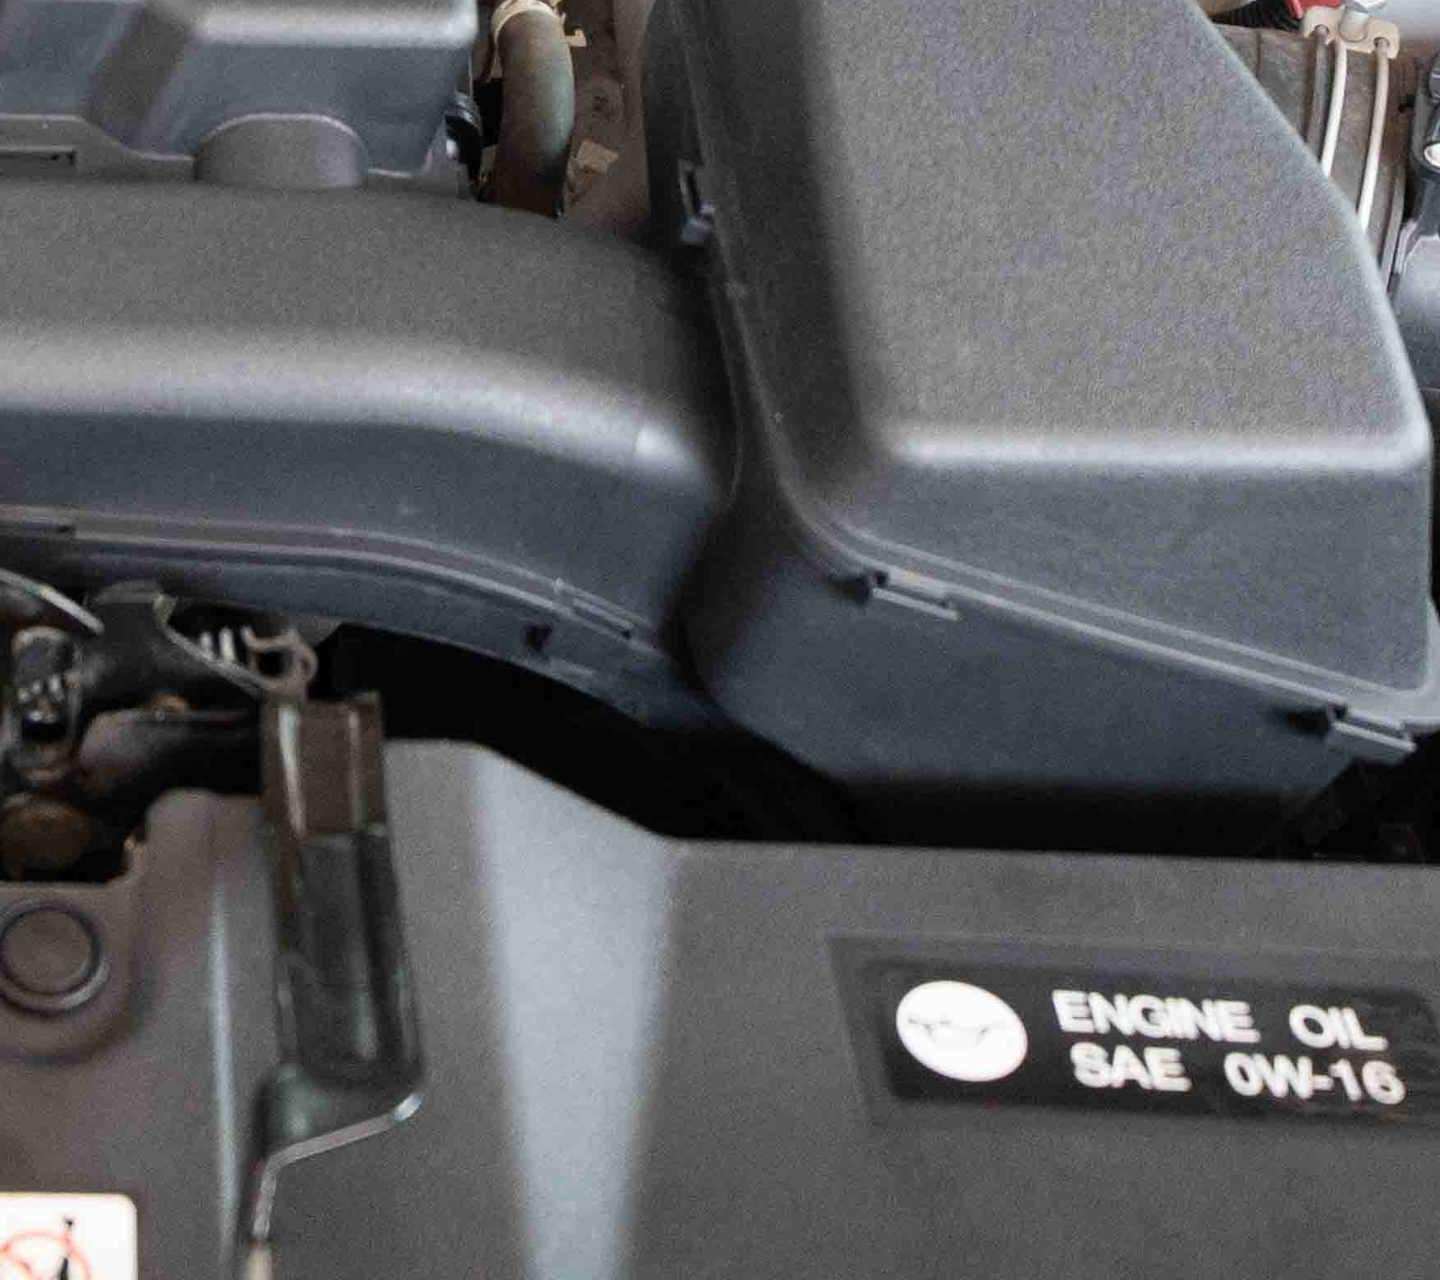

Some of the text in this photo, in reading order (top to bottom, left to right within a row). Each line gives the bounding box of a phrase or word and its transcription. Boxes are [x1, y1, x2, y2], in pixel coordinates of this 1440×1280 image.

[1051, 989, 1388, 1052] ENGINE OIL
[1069, 1042, 1406, 1105] SAE 0W-16
